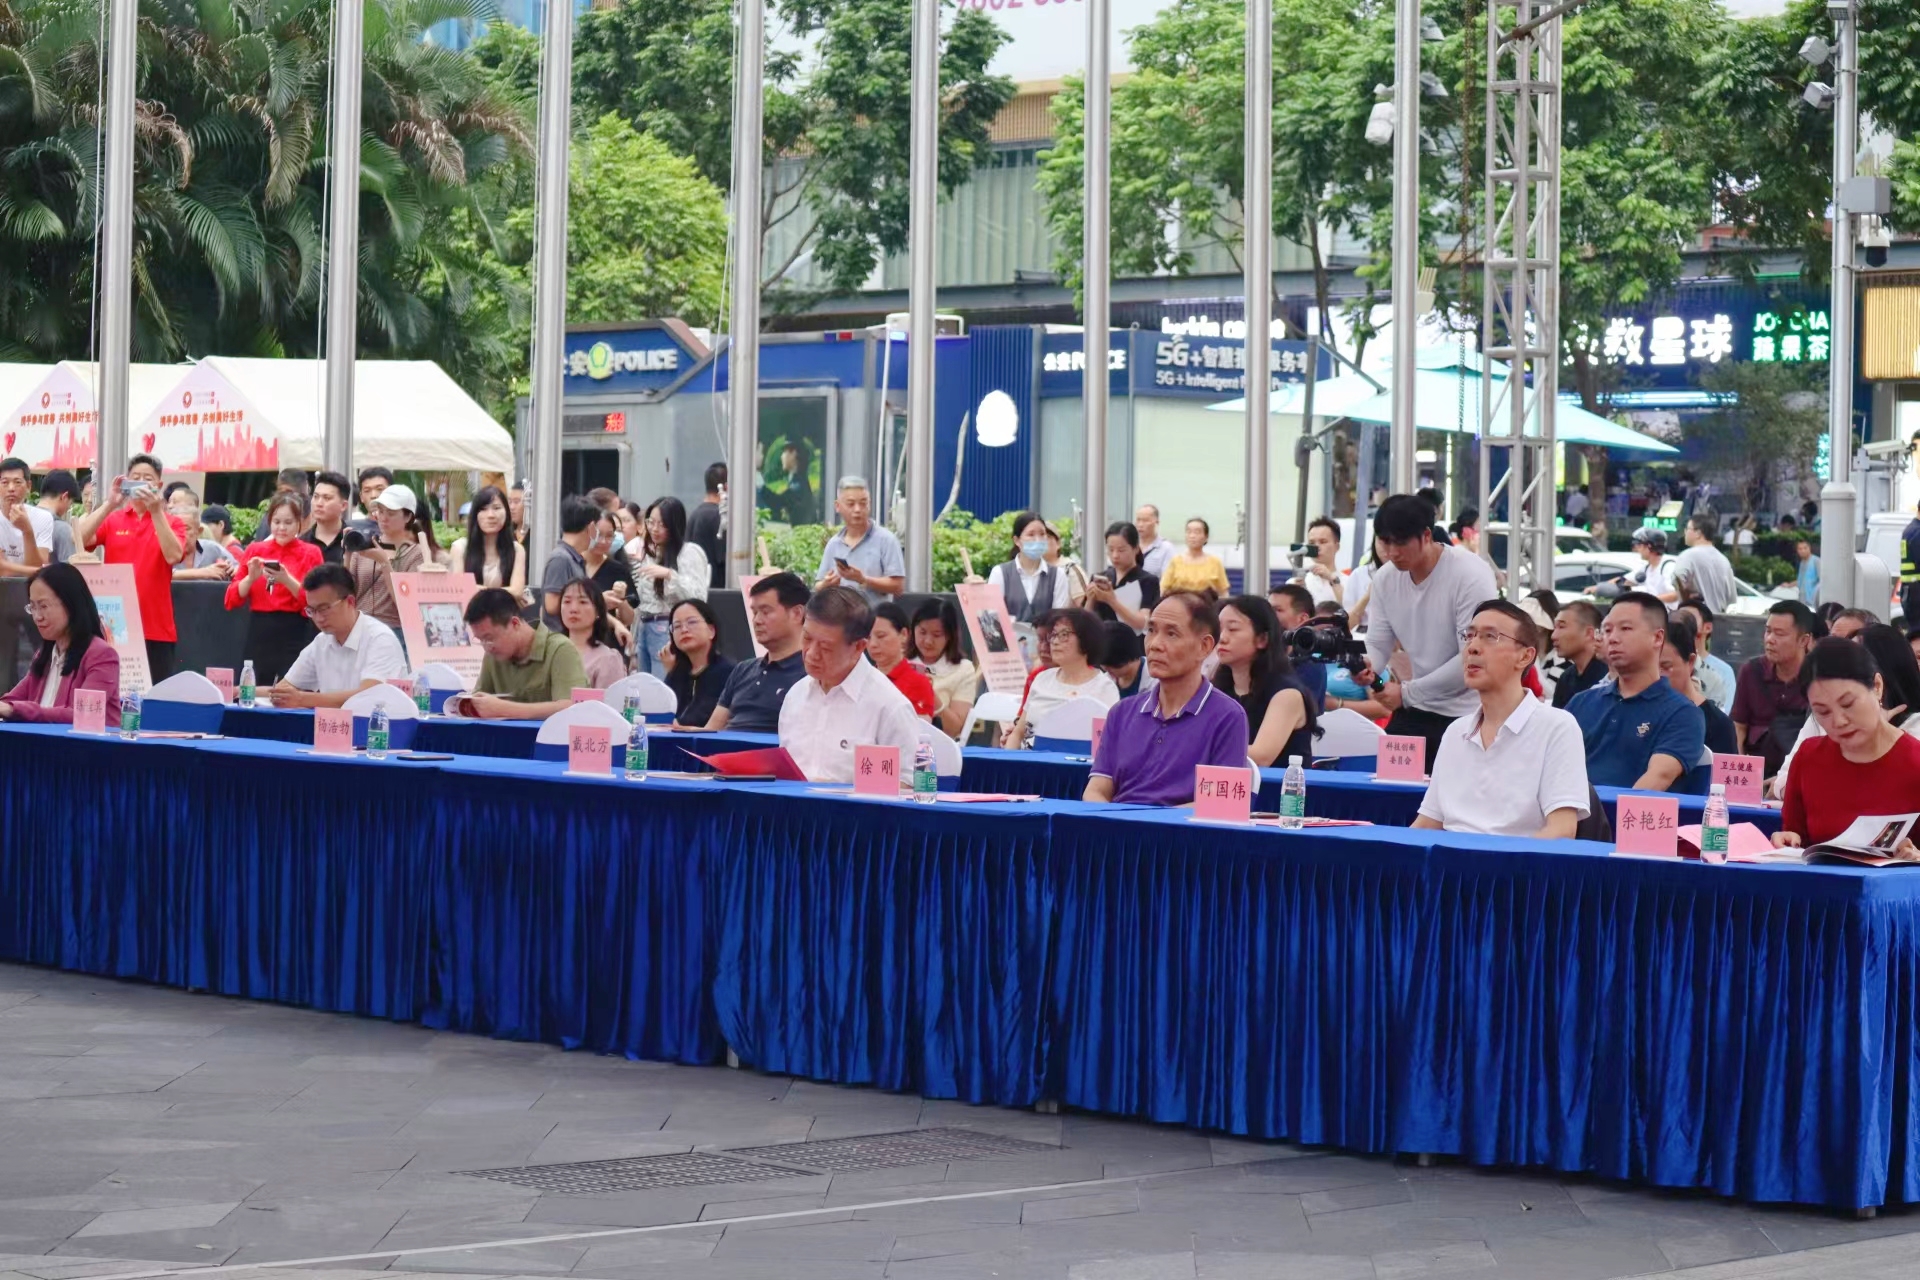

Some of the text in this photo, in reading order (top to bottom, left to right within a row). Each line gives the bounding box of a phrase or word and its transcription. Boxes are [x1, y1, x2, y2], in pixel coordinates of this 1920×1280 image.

[563, 348, 678, 376] 安 POLICE
[1156, 369, 1175, 386] 5G
[1186, 371, 1241, 392] Intelligent
[572, 736, 608, 753] 戴北方
[860, 757, 893, 776] 徐刚
[1389, 755, 1412, 765] 委员会
[1720, 761, 1753, 773] 卫生健康
[1198, 777, 1246, 801] 何国伟
[1724, 775, 1749, 786] 委员会
[1622, 808, 1674, 831] 余艳红
